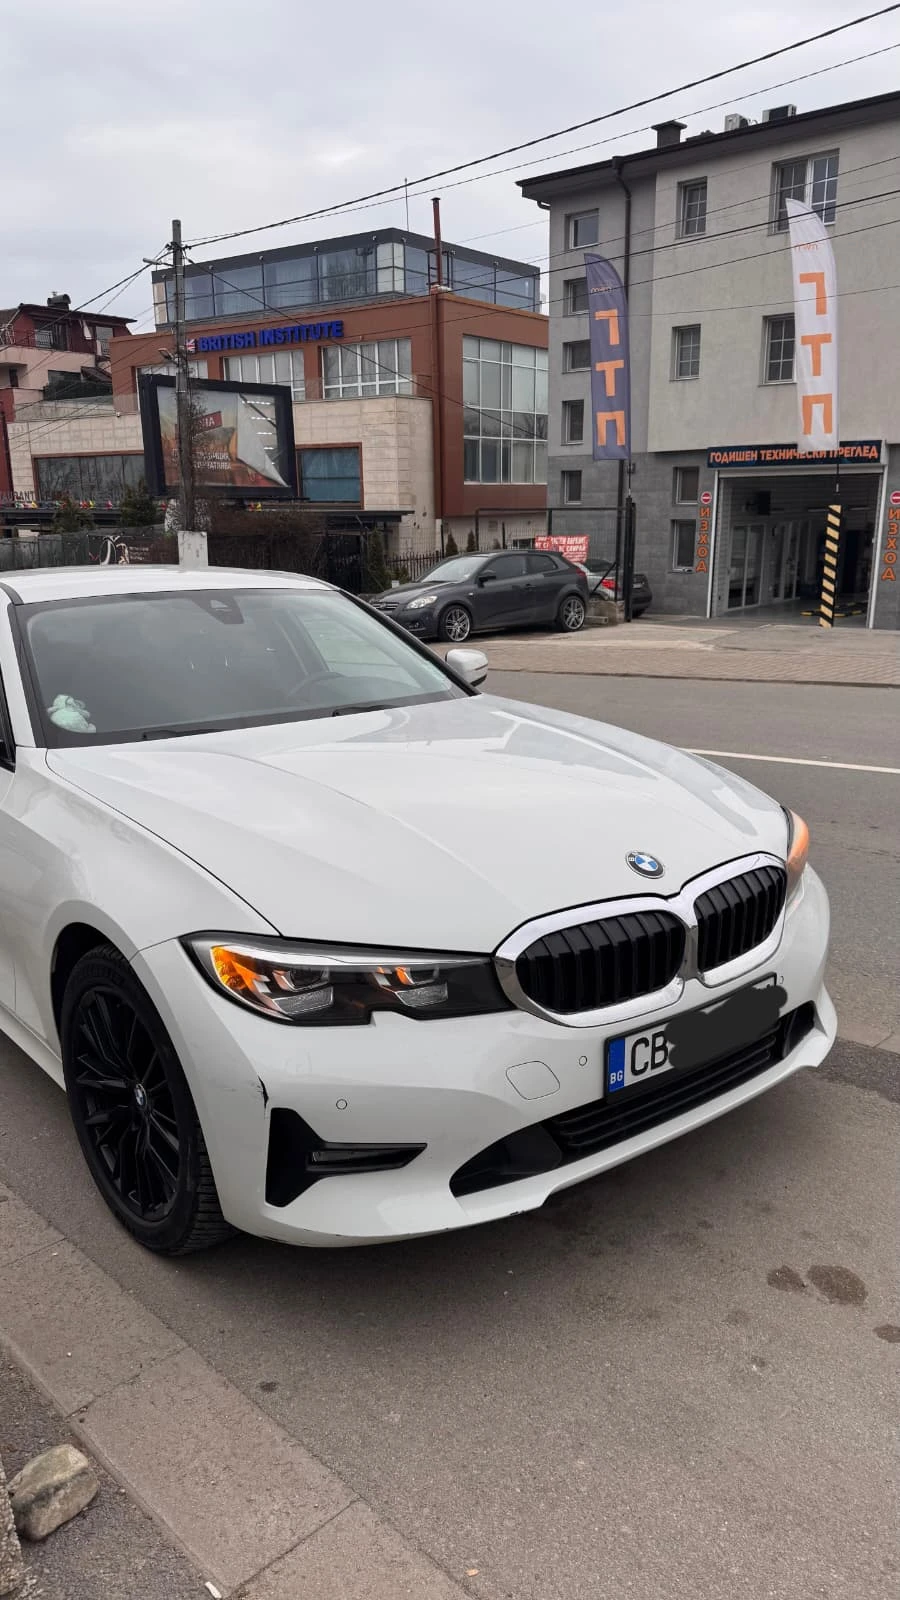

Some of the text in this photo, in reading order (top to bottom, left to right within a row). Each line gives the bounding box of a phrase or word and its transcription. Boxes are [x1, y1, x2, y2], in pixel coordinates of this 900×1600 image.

[197, 320, 344, 353] BRITISH INSTITUTE
[709, 449, 758, 463] ГОДИШЕН
[695, 507, 711, 574] ИЗХОД
[881, 507, 900, 581] ИЗХОД
[631, 1031, 668, 1076] CB
[610, 1070, 623, 1084] BG
